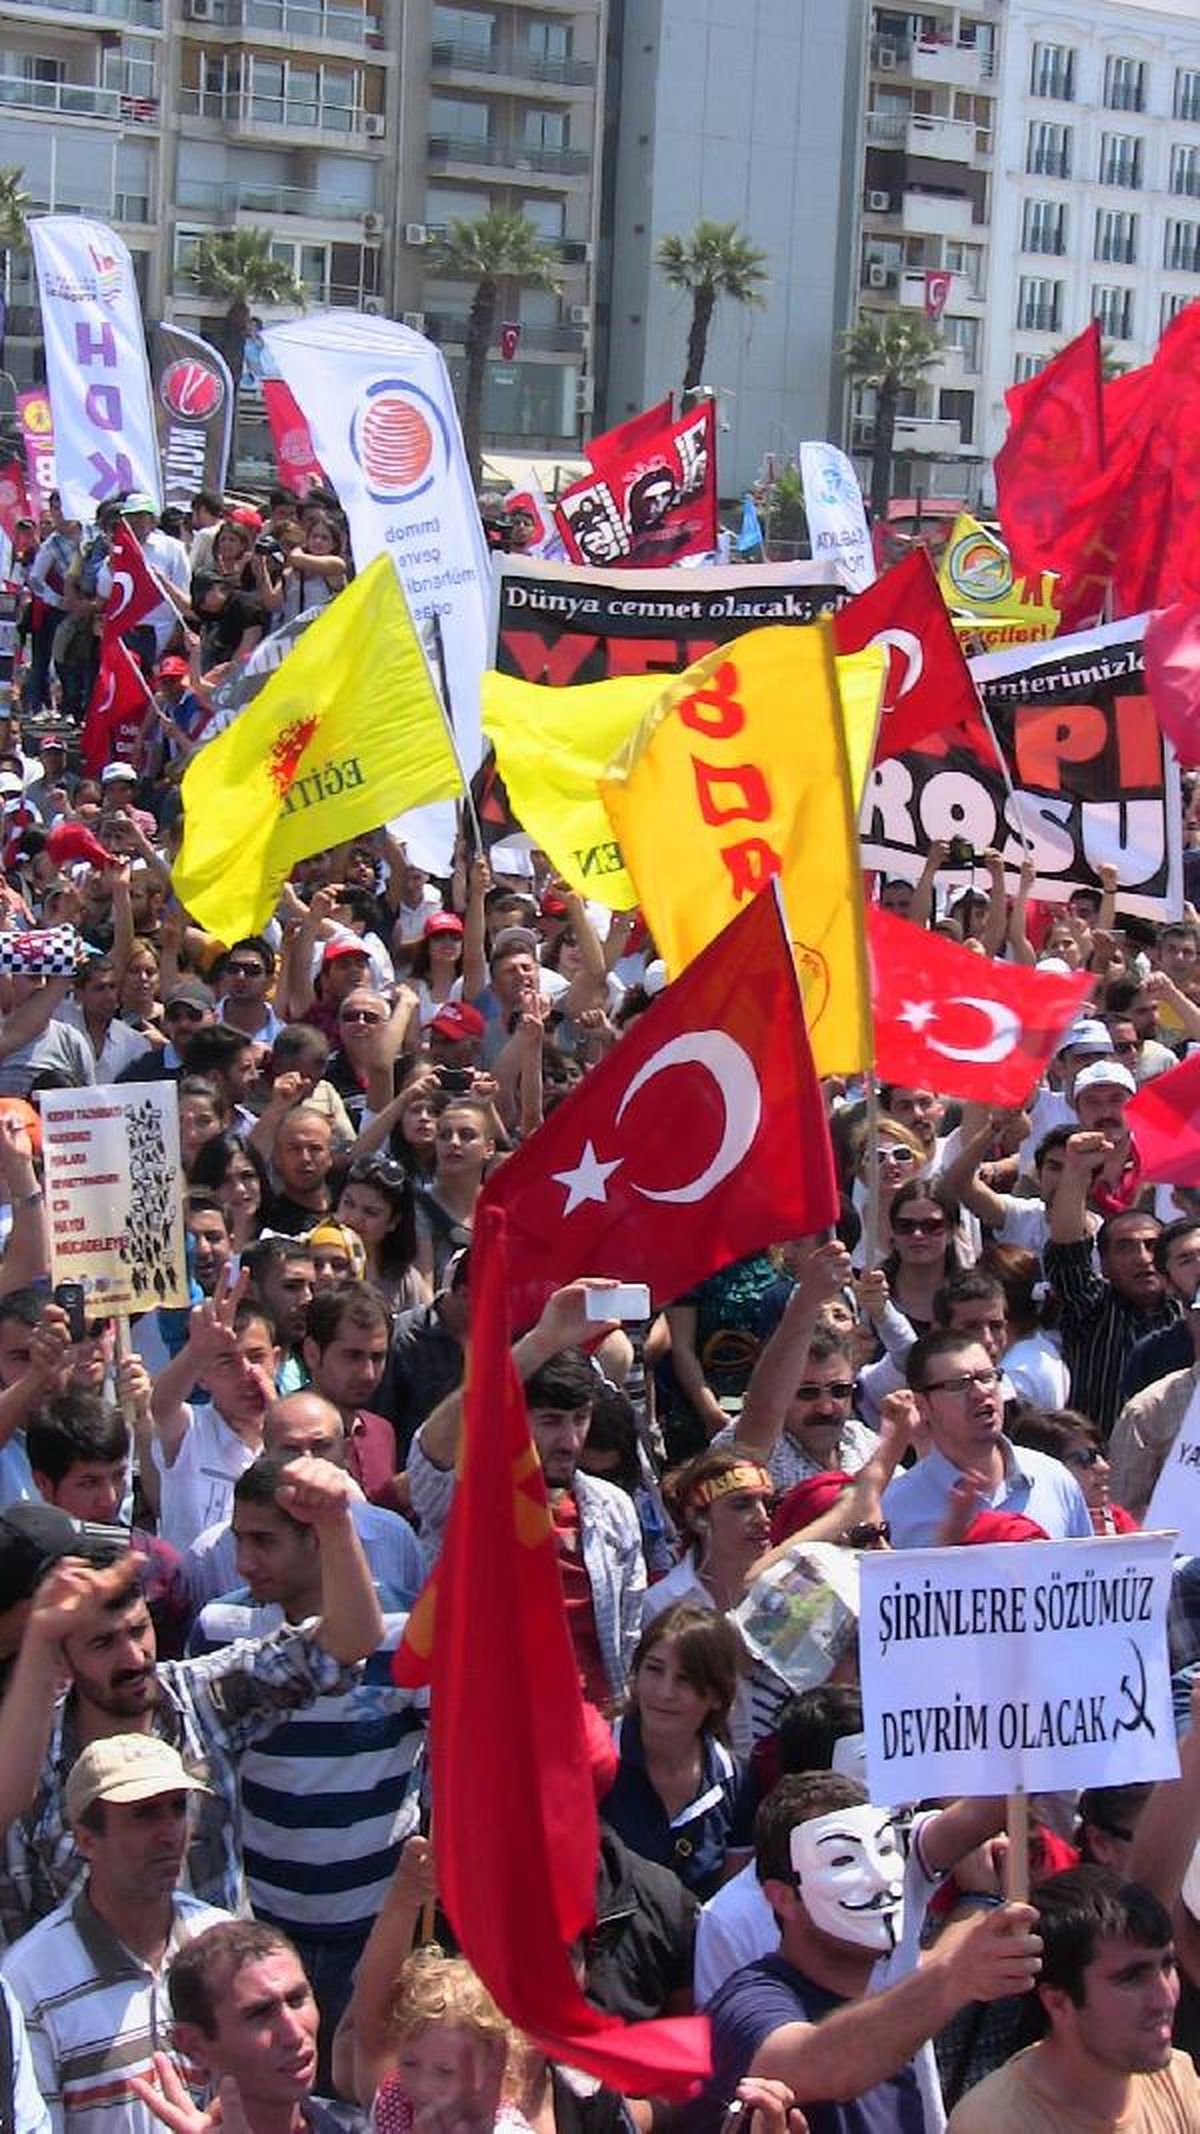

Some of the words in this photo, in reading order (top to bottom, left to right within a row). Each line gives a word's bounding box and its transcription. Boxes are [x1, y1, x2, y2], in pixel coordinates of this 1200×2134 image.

[506, 586, 599, 620] Dünya
[607, 599, 702, 619] cennet
[709, 595, 812, 620] olacak;
[501, 630, 722, 688] YE
[879, 1580, 1027, 1656] ŞİRİNLERE
[1034, 1567, 1154, 1633] SÖZÜMÜZ
[881, 1693, 988, 1761] DEVRİM
[1000, 1695, 1107, 1750] OLACAK
